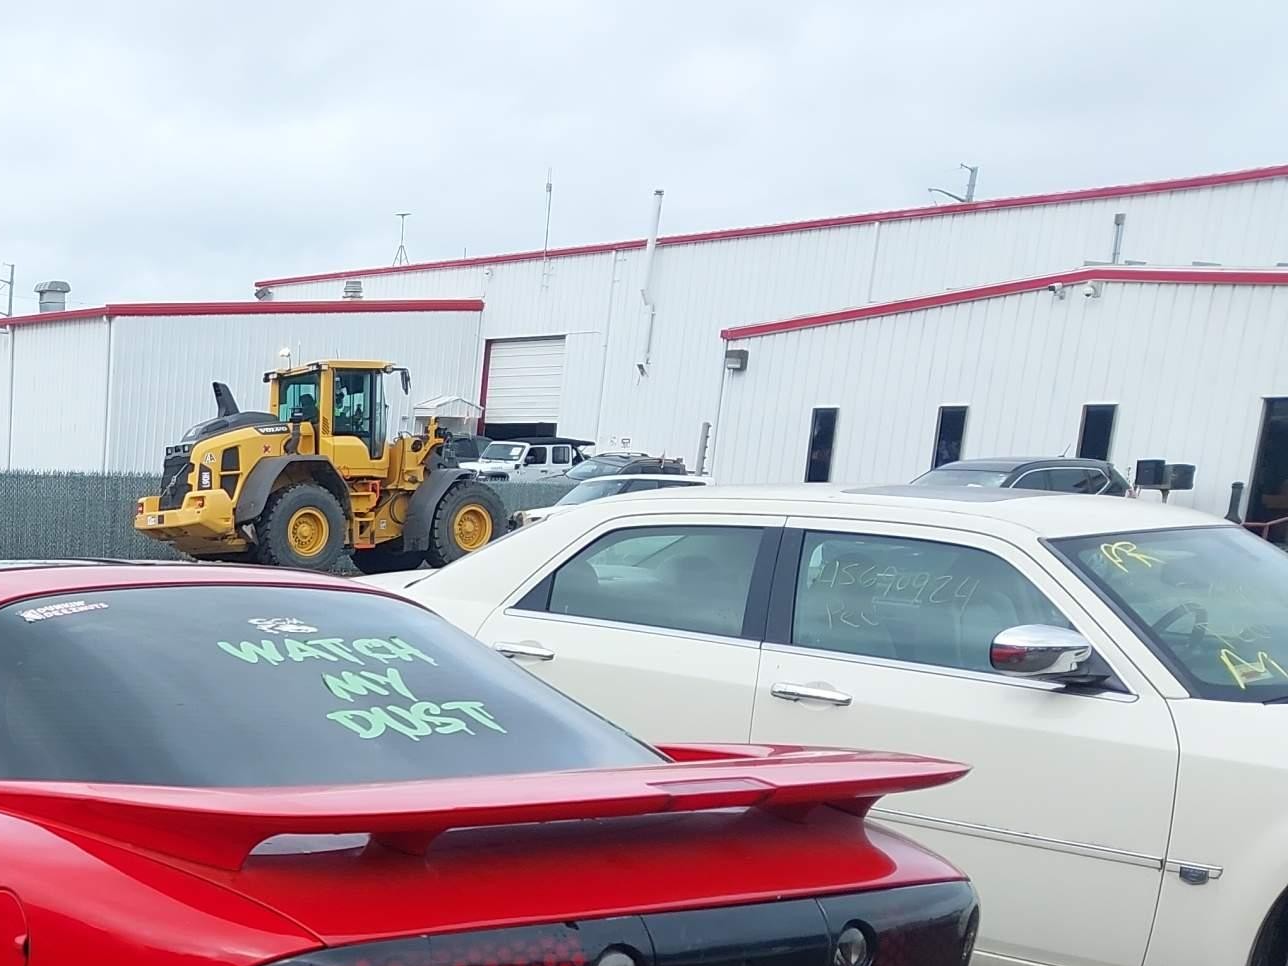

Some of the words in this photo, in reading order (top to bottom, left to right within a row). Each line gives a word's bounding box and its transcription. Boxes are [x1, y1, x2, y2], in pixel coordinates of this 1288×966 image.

[216, 636, 439, 666] WATCH
[322, 667, 419, 703] MY
[326, 701, 508, 741] DUST
